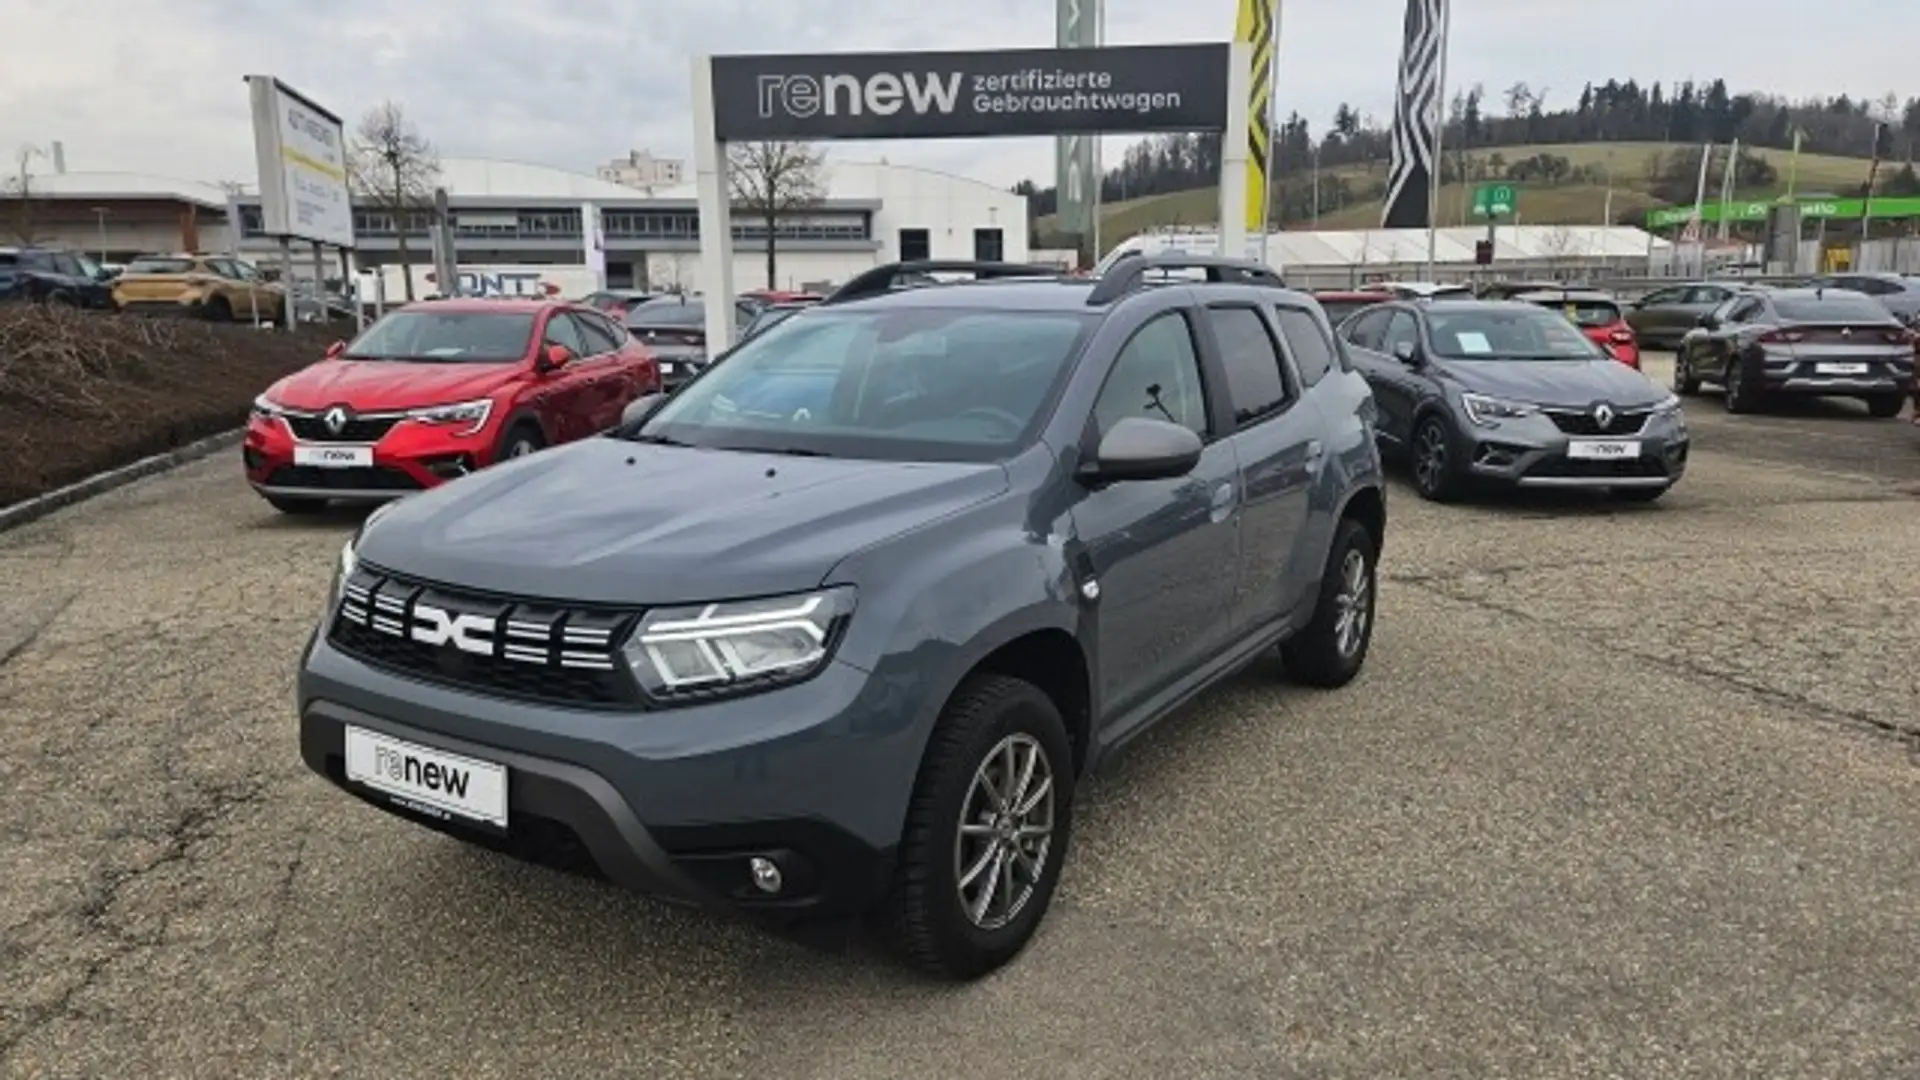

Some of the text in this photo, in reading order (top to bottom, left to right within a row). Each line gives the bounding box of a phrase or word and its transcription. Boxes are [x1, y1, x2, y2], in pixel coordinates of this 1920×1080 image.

[757, 72, 963, 118] renew
[973, 68, 1112, 91] zertifizierte
[972, 90, 1181, 114] Gebrauchtwagen
[374, 744, 469, 799] renew
